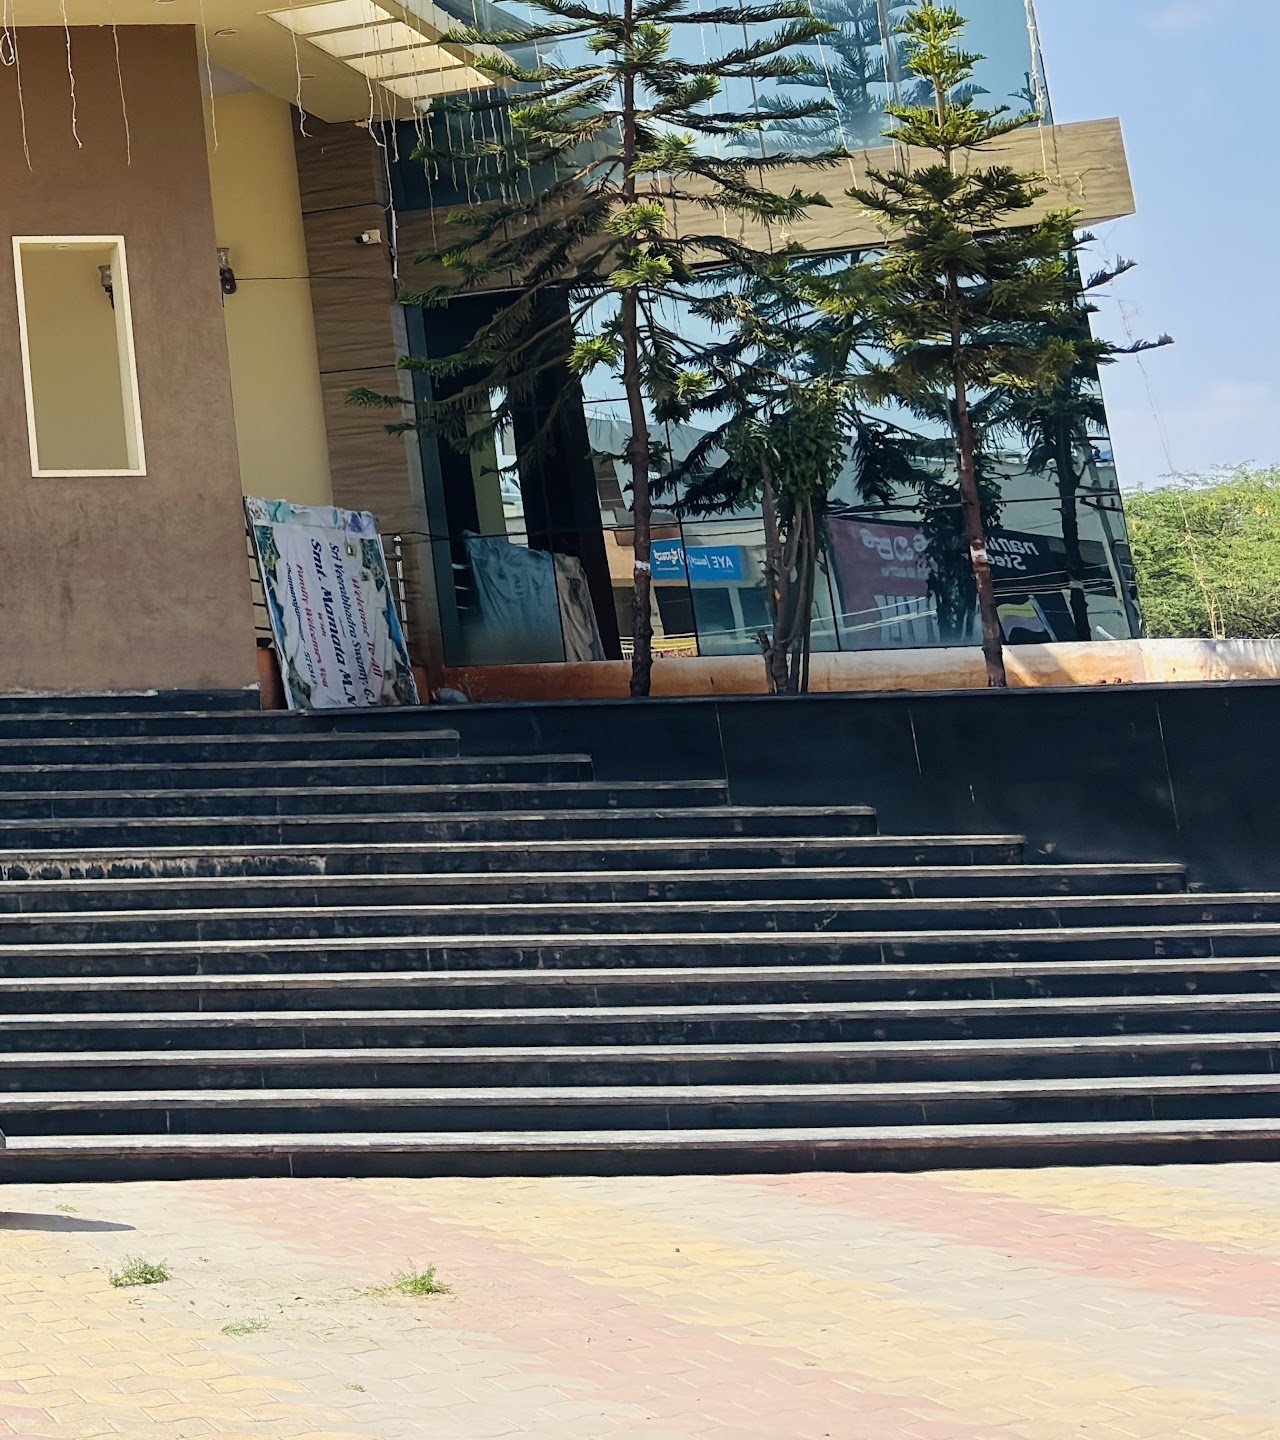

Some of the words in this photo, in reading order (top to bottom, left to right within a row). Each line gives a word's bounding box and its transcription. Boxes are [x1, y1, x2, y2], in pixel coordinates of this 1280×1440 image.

[329, 543, 342, 561] Sri
[311, 539, 327, 581] Smt.
[321, 586, 346, 666] Mamata
[352, 578, 370, 638] Welcome
